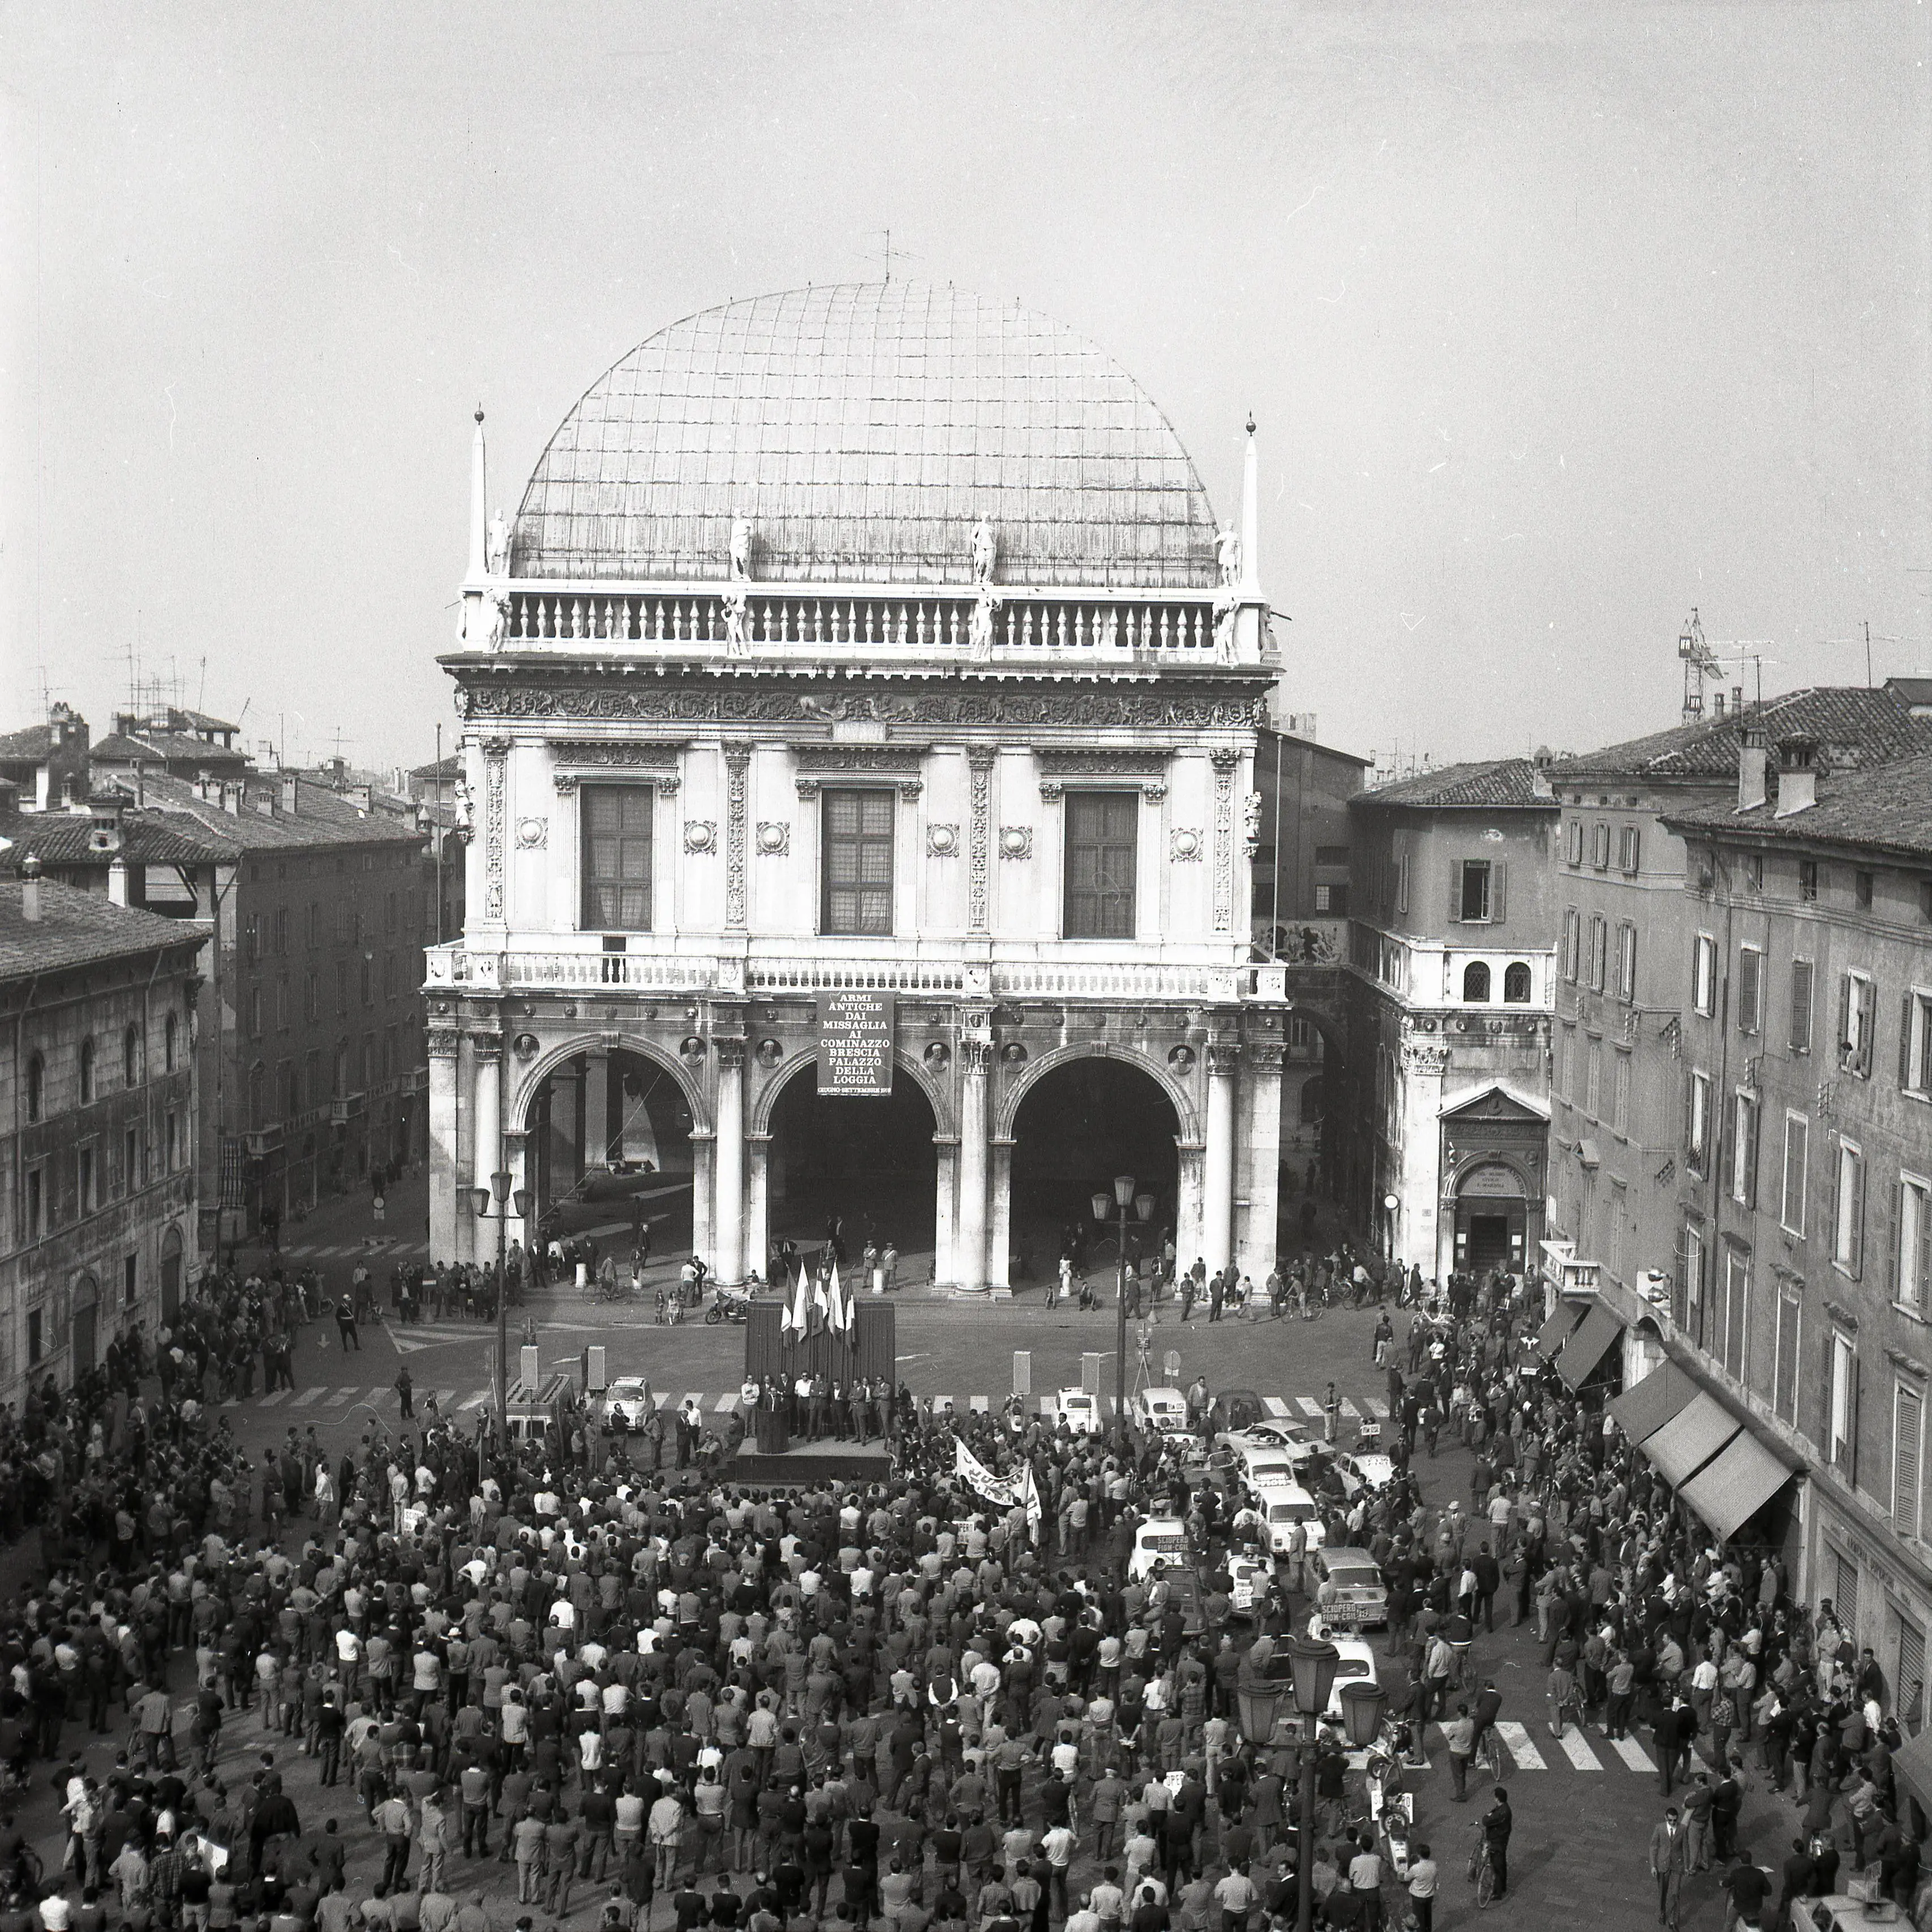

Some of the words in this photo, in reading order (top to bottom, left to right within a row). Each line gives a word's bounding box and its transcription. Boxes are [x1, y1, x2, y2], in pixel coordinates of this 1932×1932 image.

[821, 1039, 890, 1047] COMINAZZO
[829, 1048, 881, 1057] BRESCIA
[1322, 1603, 1356, 1613] SCIOPERO
[1323, 1612, 1357, 1621] FIOM-CGIL
